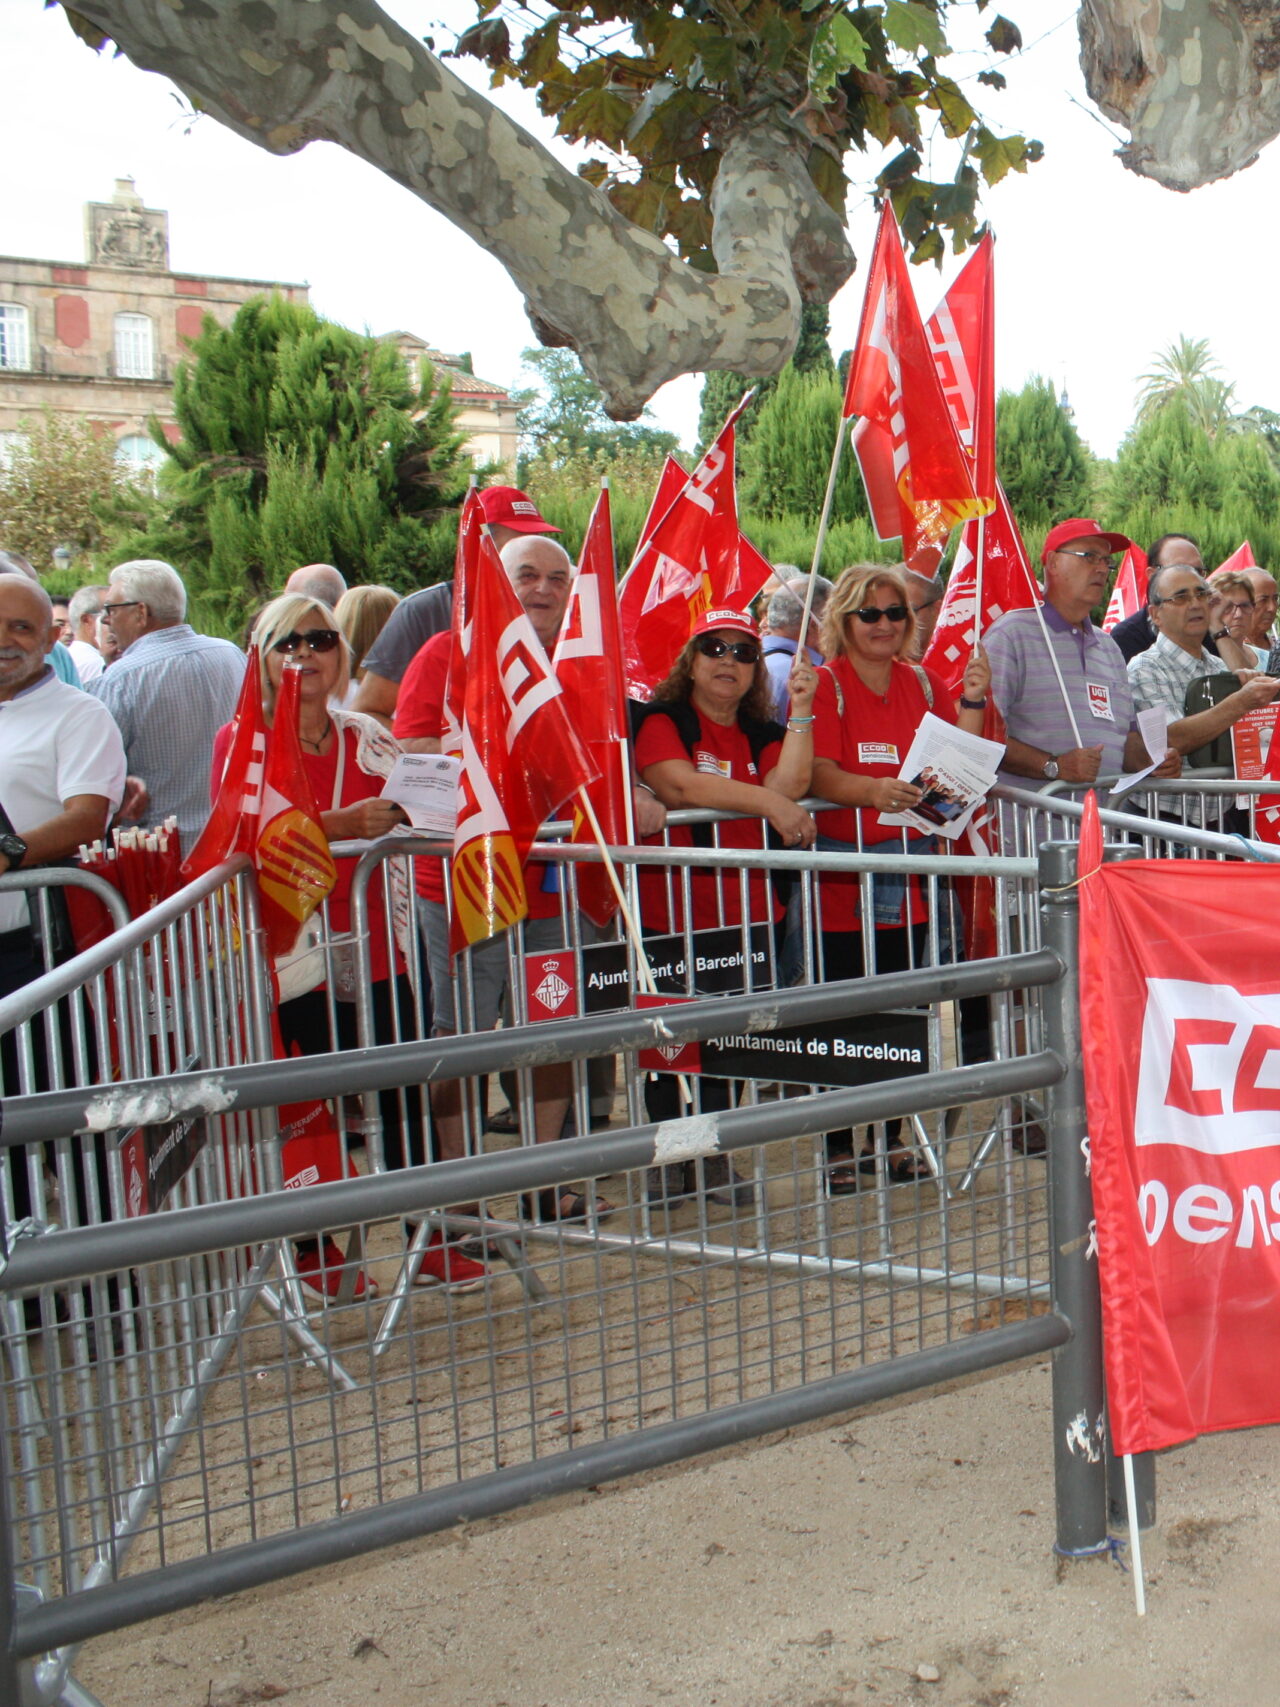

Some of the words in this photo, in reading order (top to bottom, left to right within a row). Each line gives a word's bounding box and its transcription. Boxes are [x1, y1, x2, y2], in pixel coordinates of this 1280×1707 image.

[1091, 686, 1107, 698] UGT
[863, 744, 887, 752] CCOO
[588, 964, 672, 990] Ajuntent
[695, 951, 766, 972] Barcelna
[807, 1038, 828, 1056] de
[833, 1038, 922, 1064] Barcelona
